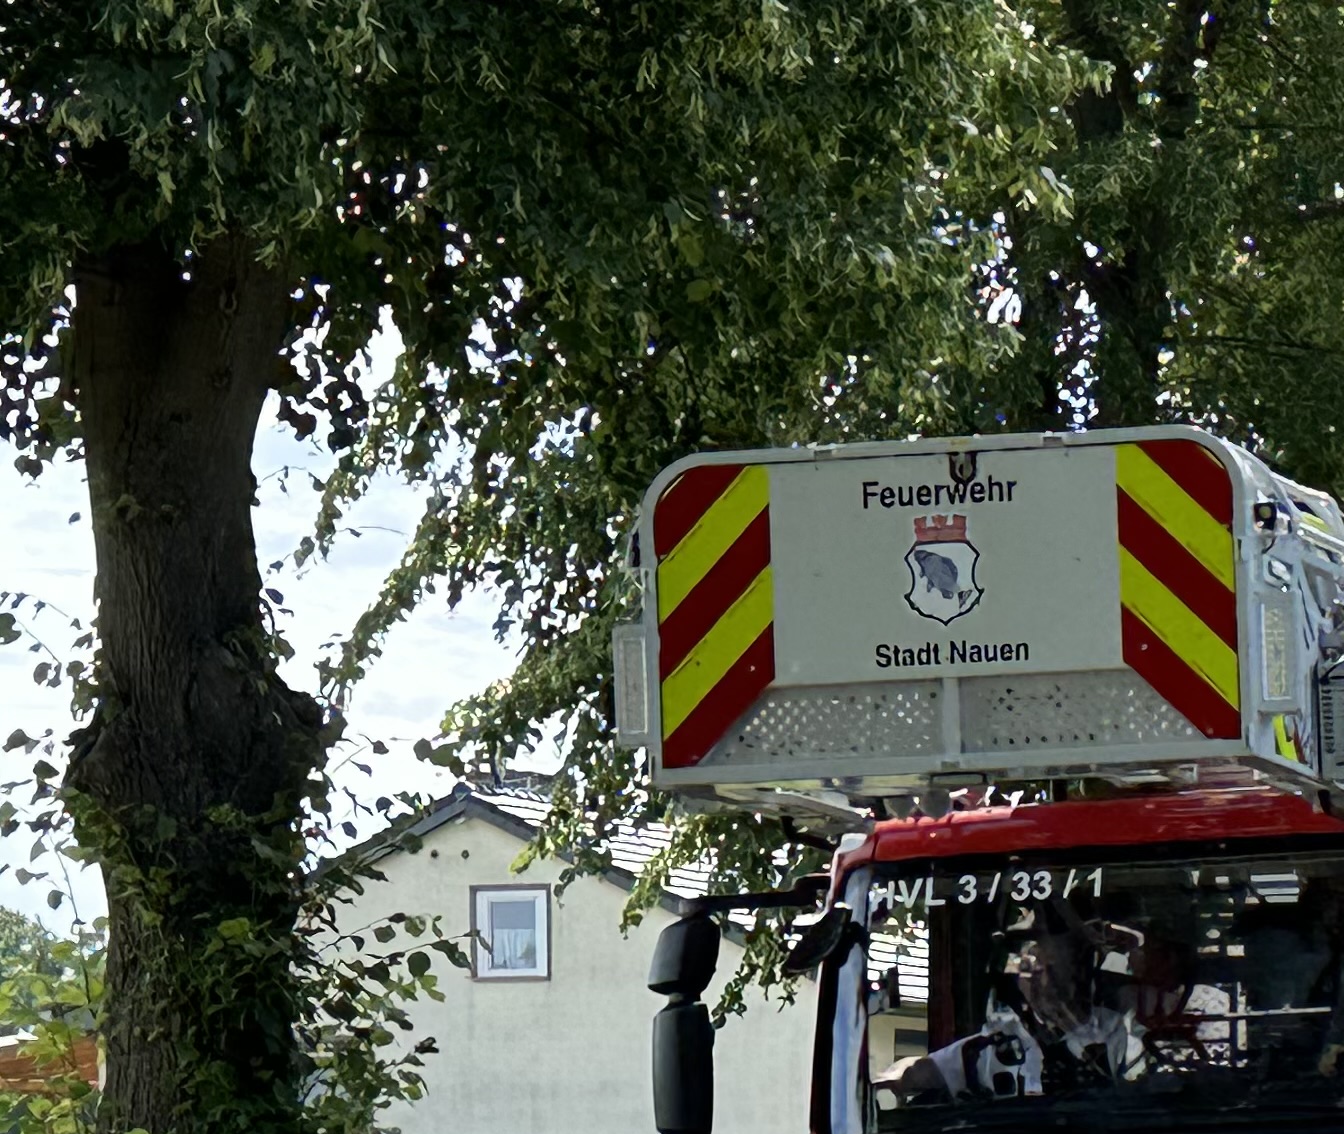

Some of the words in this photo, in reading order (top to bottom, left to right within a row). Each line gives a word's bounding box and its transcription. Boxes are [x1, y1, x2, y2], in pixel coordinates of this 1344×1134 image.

[862, 475, 1017, 509] Feuerwehr
[876, 642, 941, 668] Stadt
[949, 640, 1029, 664] Nauen
[869, 877, 946, 911] HVL
[1010, 871, 1052, 901] 33
